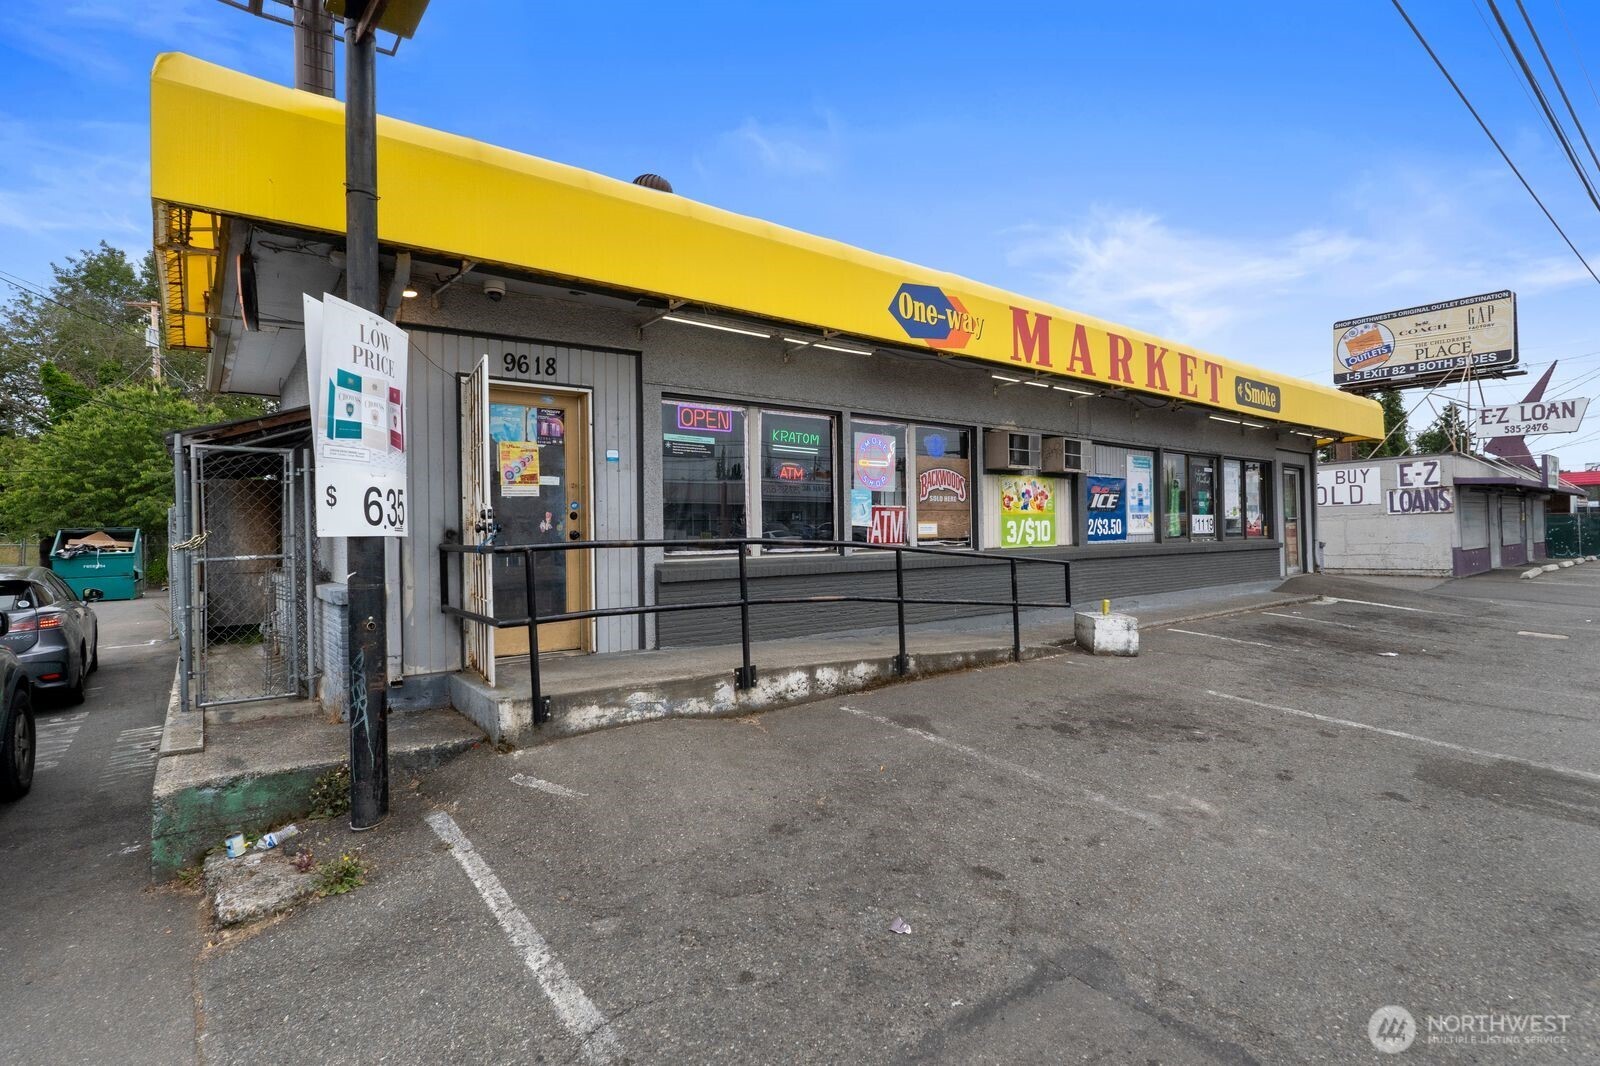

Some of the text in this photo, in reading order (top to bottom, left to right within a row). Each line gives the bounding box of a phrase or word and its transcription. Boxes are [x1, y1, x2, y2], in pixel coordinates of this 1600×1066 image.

[898, 291, 985, 341] One-way
[1334, 292, 1509, 329] SHOP NORTHWEST'S ORIGINAL OUTLET DESTINATION
[1467, 304, 1495, 326] GAP
[359, 323, 392, 353] LOW
[1399, 323, 1447, 336] COACH
[1430, 335, 1472, 346] CHILDREN'S
[352, 344, 395, 379] PRICE
[1008, 305, 1224, 404] MARKET
[1348, 346, 1389, 365] OUTLETS
[1415, 341, 1473, 361] PLACE
[503, 352, 557, 376] 9618
[1346, 372, 1361, 381] I-5
[1363, 368, 1390, 379] EXIT
[1391, 365, 1407, 376] 82
[1418, 359, 1453, 371] BOTH
[1244, 381, 1277, 408] Smoke
[680, 408, 729, 430] OPEN
[1479, 401, 1577, 425] E-Z LOAN
[772, 429, 820, 446] KRATOM
[1504, 422, 1549, 434] 535-2476
[860, 437, 887, 452] SMOKE
[779, 465, 805, 481] ATM
[862, 474, 887, 488] SHOP
[1335, 468, 1370, 485] BUY
[1400, 461, 1439, 487] E-Z
[920, 468, 966, 502] BACKWOODS
[325, 484, 405, 530] $ 6.35
[929, 495, 957, 503] SOLD HERE
[1090, 493, 1120, 508] ICE
[1388, 488, 1452, 513] LOANS
[870, 510, 904, 543] ATM
[1006, 517, 1051, 545] 3/$10
[1088, 516, 1122, 537] 2/$3.50
